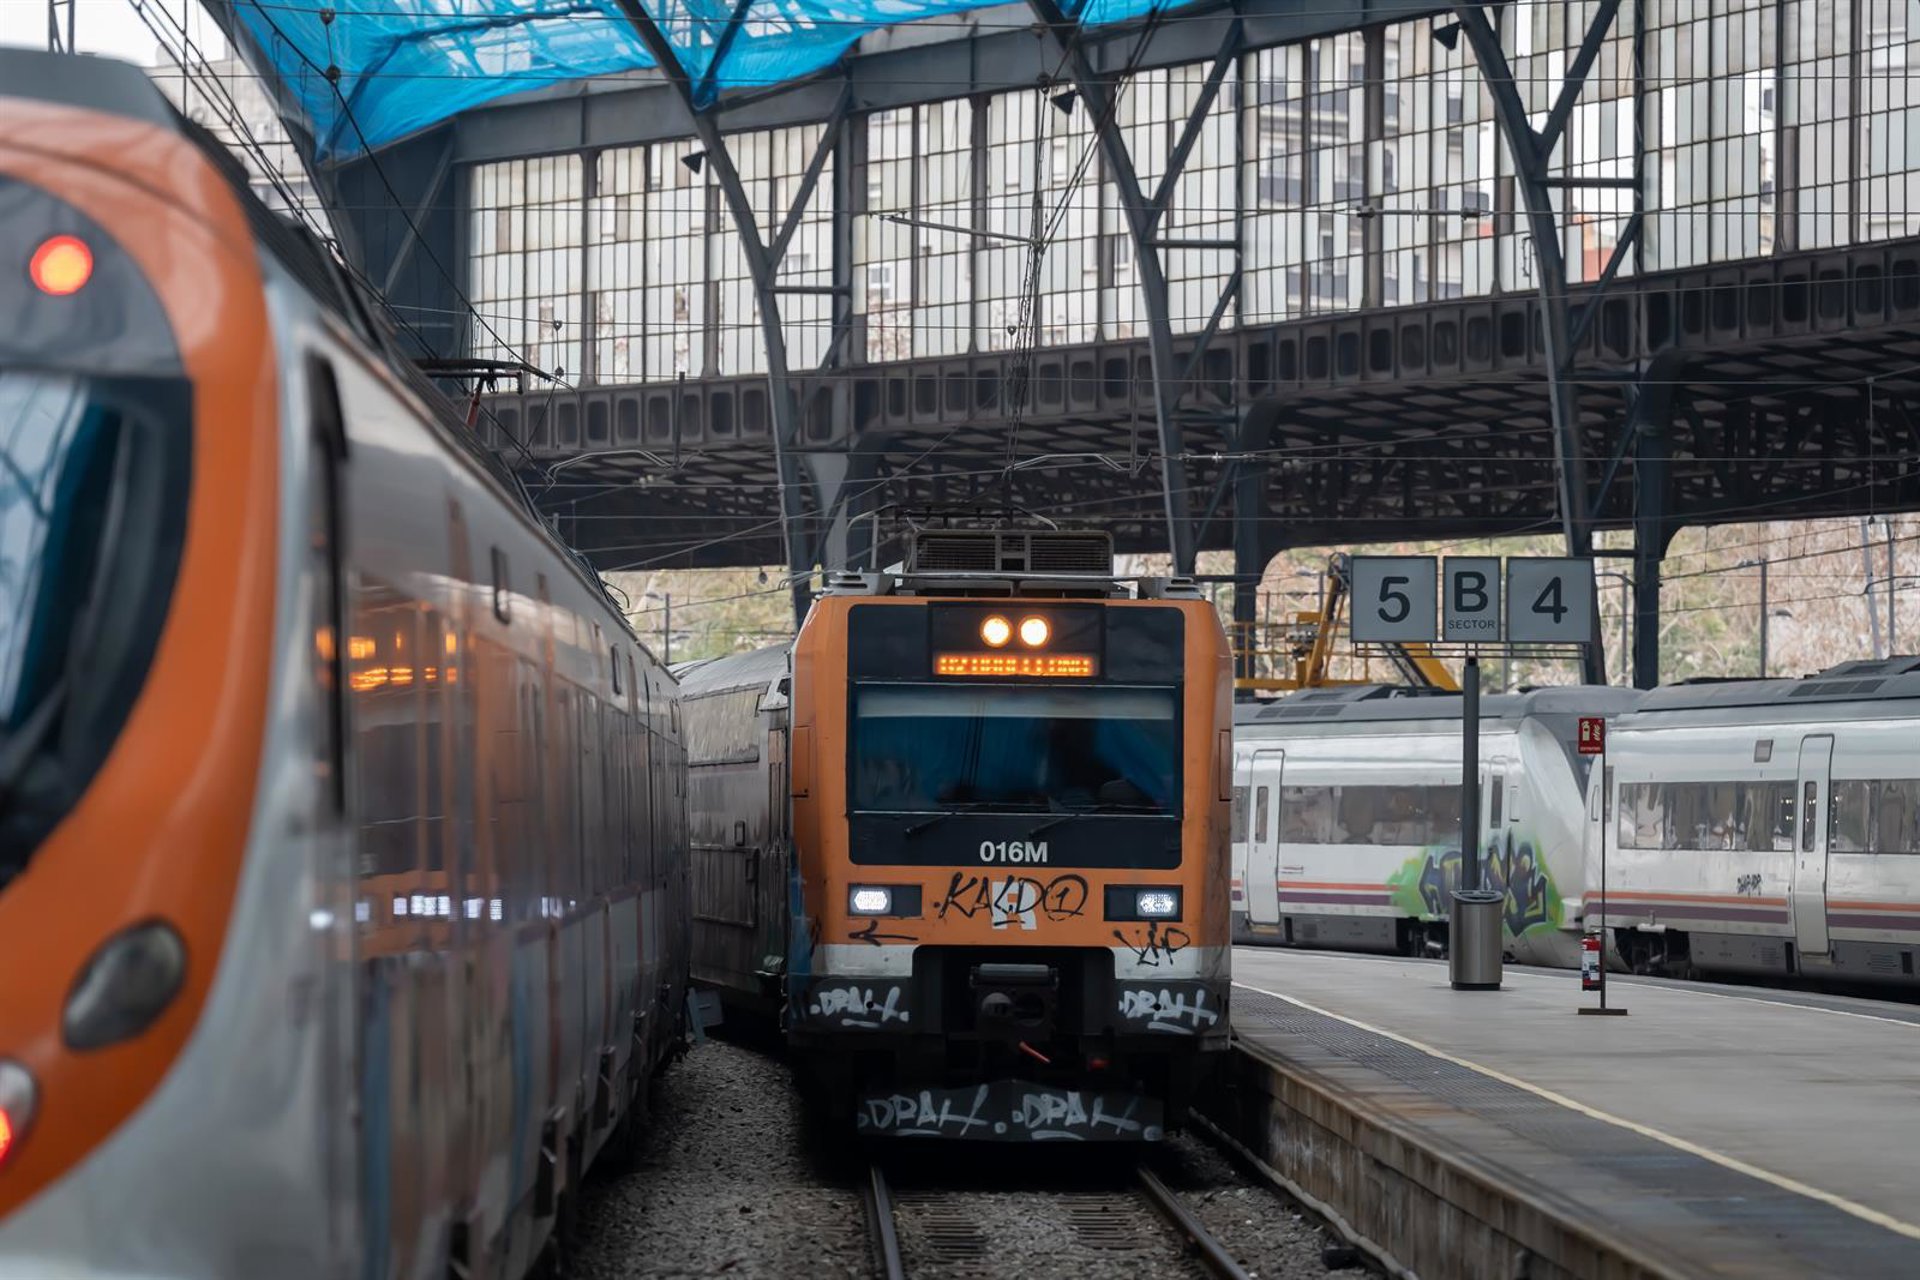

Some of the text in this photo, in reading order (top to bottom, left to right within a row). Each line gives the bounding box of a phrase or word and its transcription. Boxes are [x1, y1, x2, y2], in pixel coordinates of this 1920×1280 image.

[1377, 576, 1411, 623] 5
[1454, 571, 1489, 612] B
[1531, 576, 1568, 624] 4
[1447, 619, 1496, 630] SECTOR
[979, 841, 1049, 863] 016M
